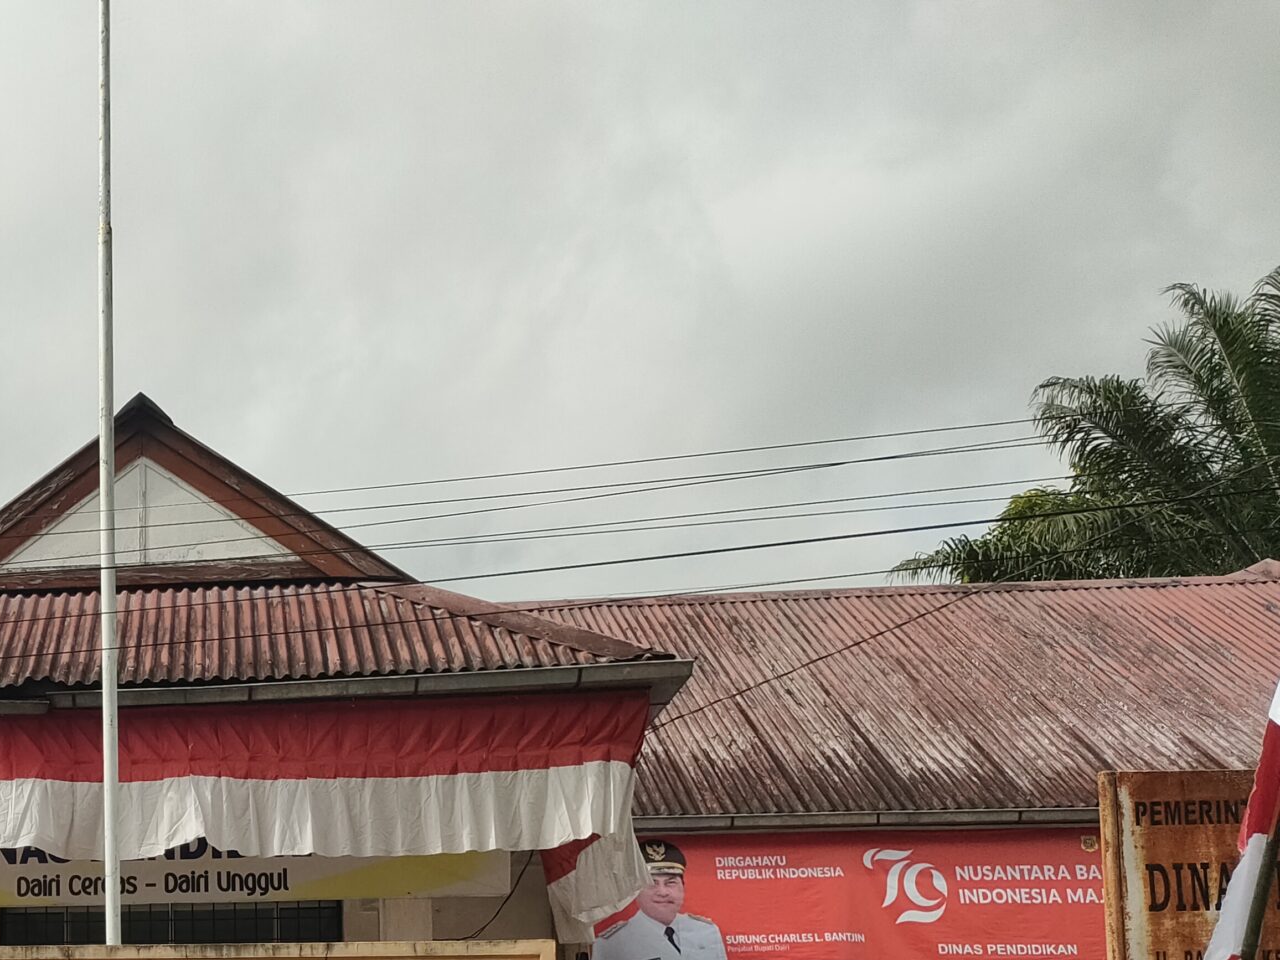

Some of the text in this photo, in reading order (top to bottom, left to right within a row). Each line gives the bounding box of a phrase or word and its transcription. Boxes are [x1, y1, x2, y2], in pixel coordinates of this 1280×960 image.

[715, 855, 786, 867] DIRGAHAYU
[717, 866, 844, 880] REPUBLIK INDONESIA
[955, 864, 1102, 881] NUSANTARA BA
[16, 874, 61, 897] Dairi
[68, 874, 138, 896] Cers
[164, 870, 210, 894] Dairi
[217, 867, 289, 896] Unggul
[958, 887, 1105, 905] INDONESIA MAJ
[726, 932, 865, 944] SURUNG CHARLES L. BANTJIN
[937, 943, 1078, 956] DINAS PENDIDIKAN
